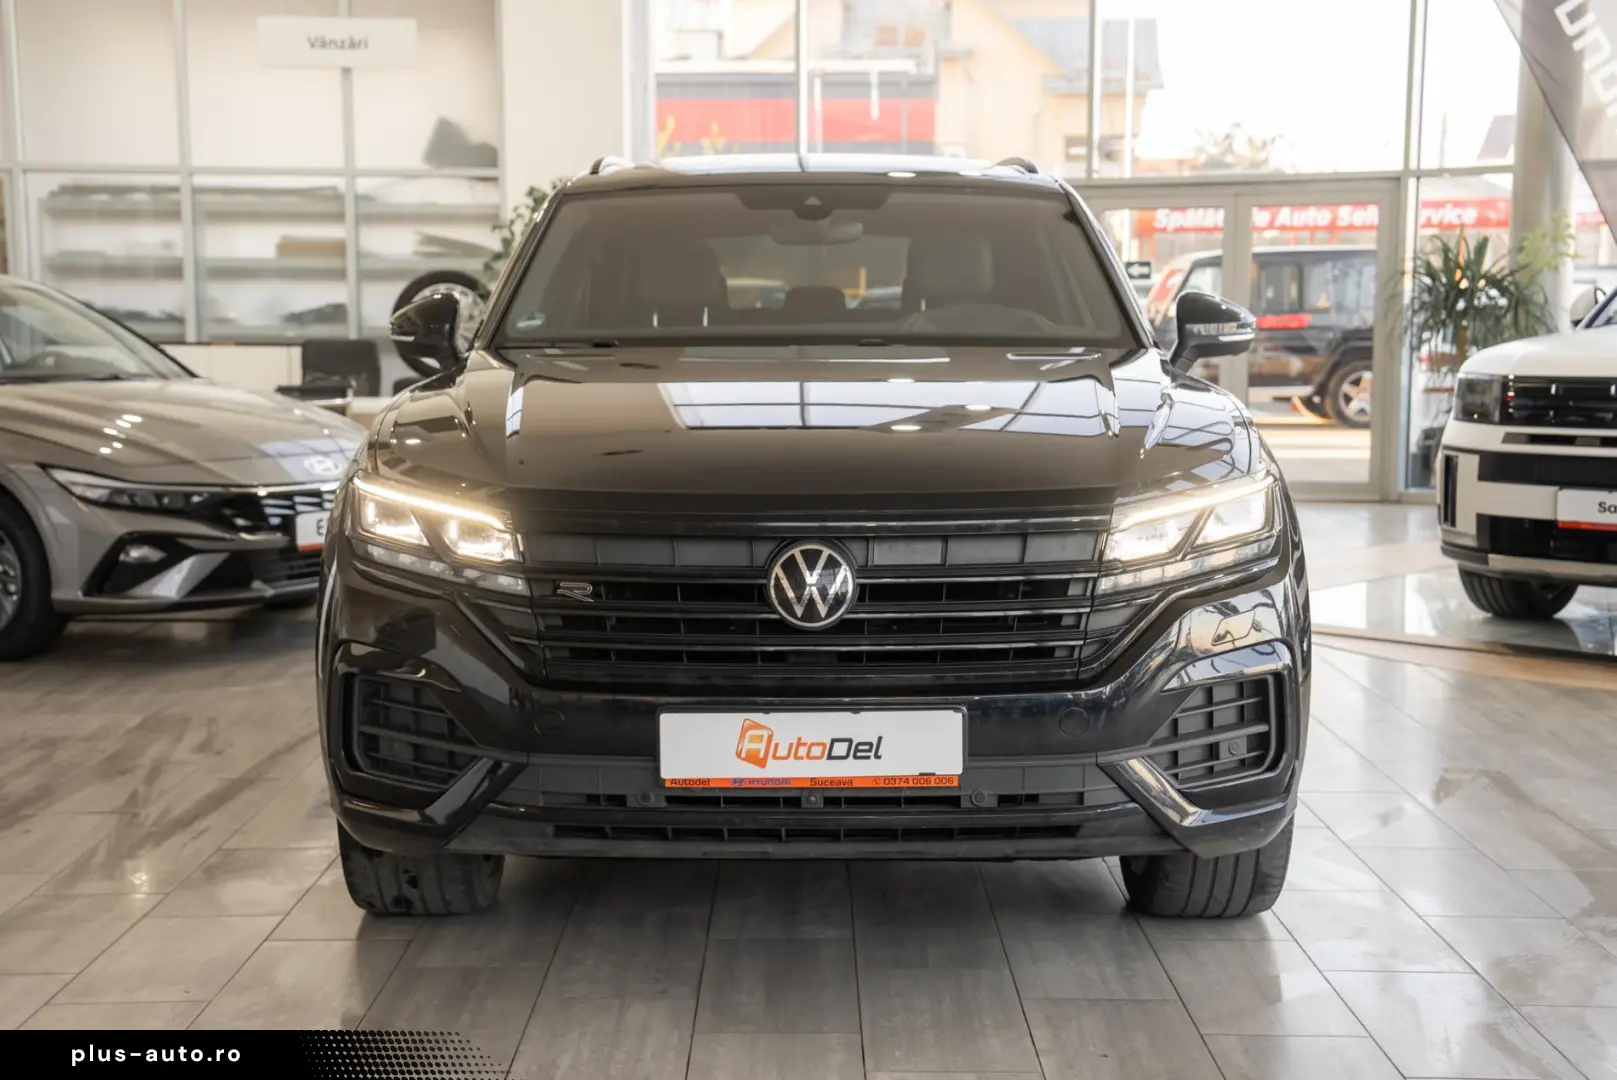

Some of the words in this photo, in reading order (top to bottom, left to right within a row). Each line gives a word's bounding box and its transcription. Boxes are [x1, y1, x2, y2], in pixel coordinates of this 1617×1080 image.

[1274, 206, 1332, 227] Auto
[1419, 203, 1478, 225] rvice
[737, 723, 883, 764] AutoDel
[670, 778, 711, 787] Autodel
[809, 777, 854, 787] Suceava
[883, 776, 910, 786] 0374
[912, 776, 932, 786] 006
[934, 776, 954, 786] 006
